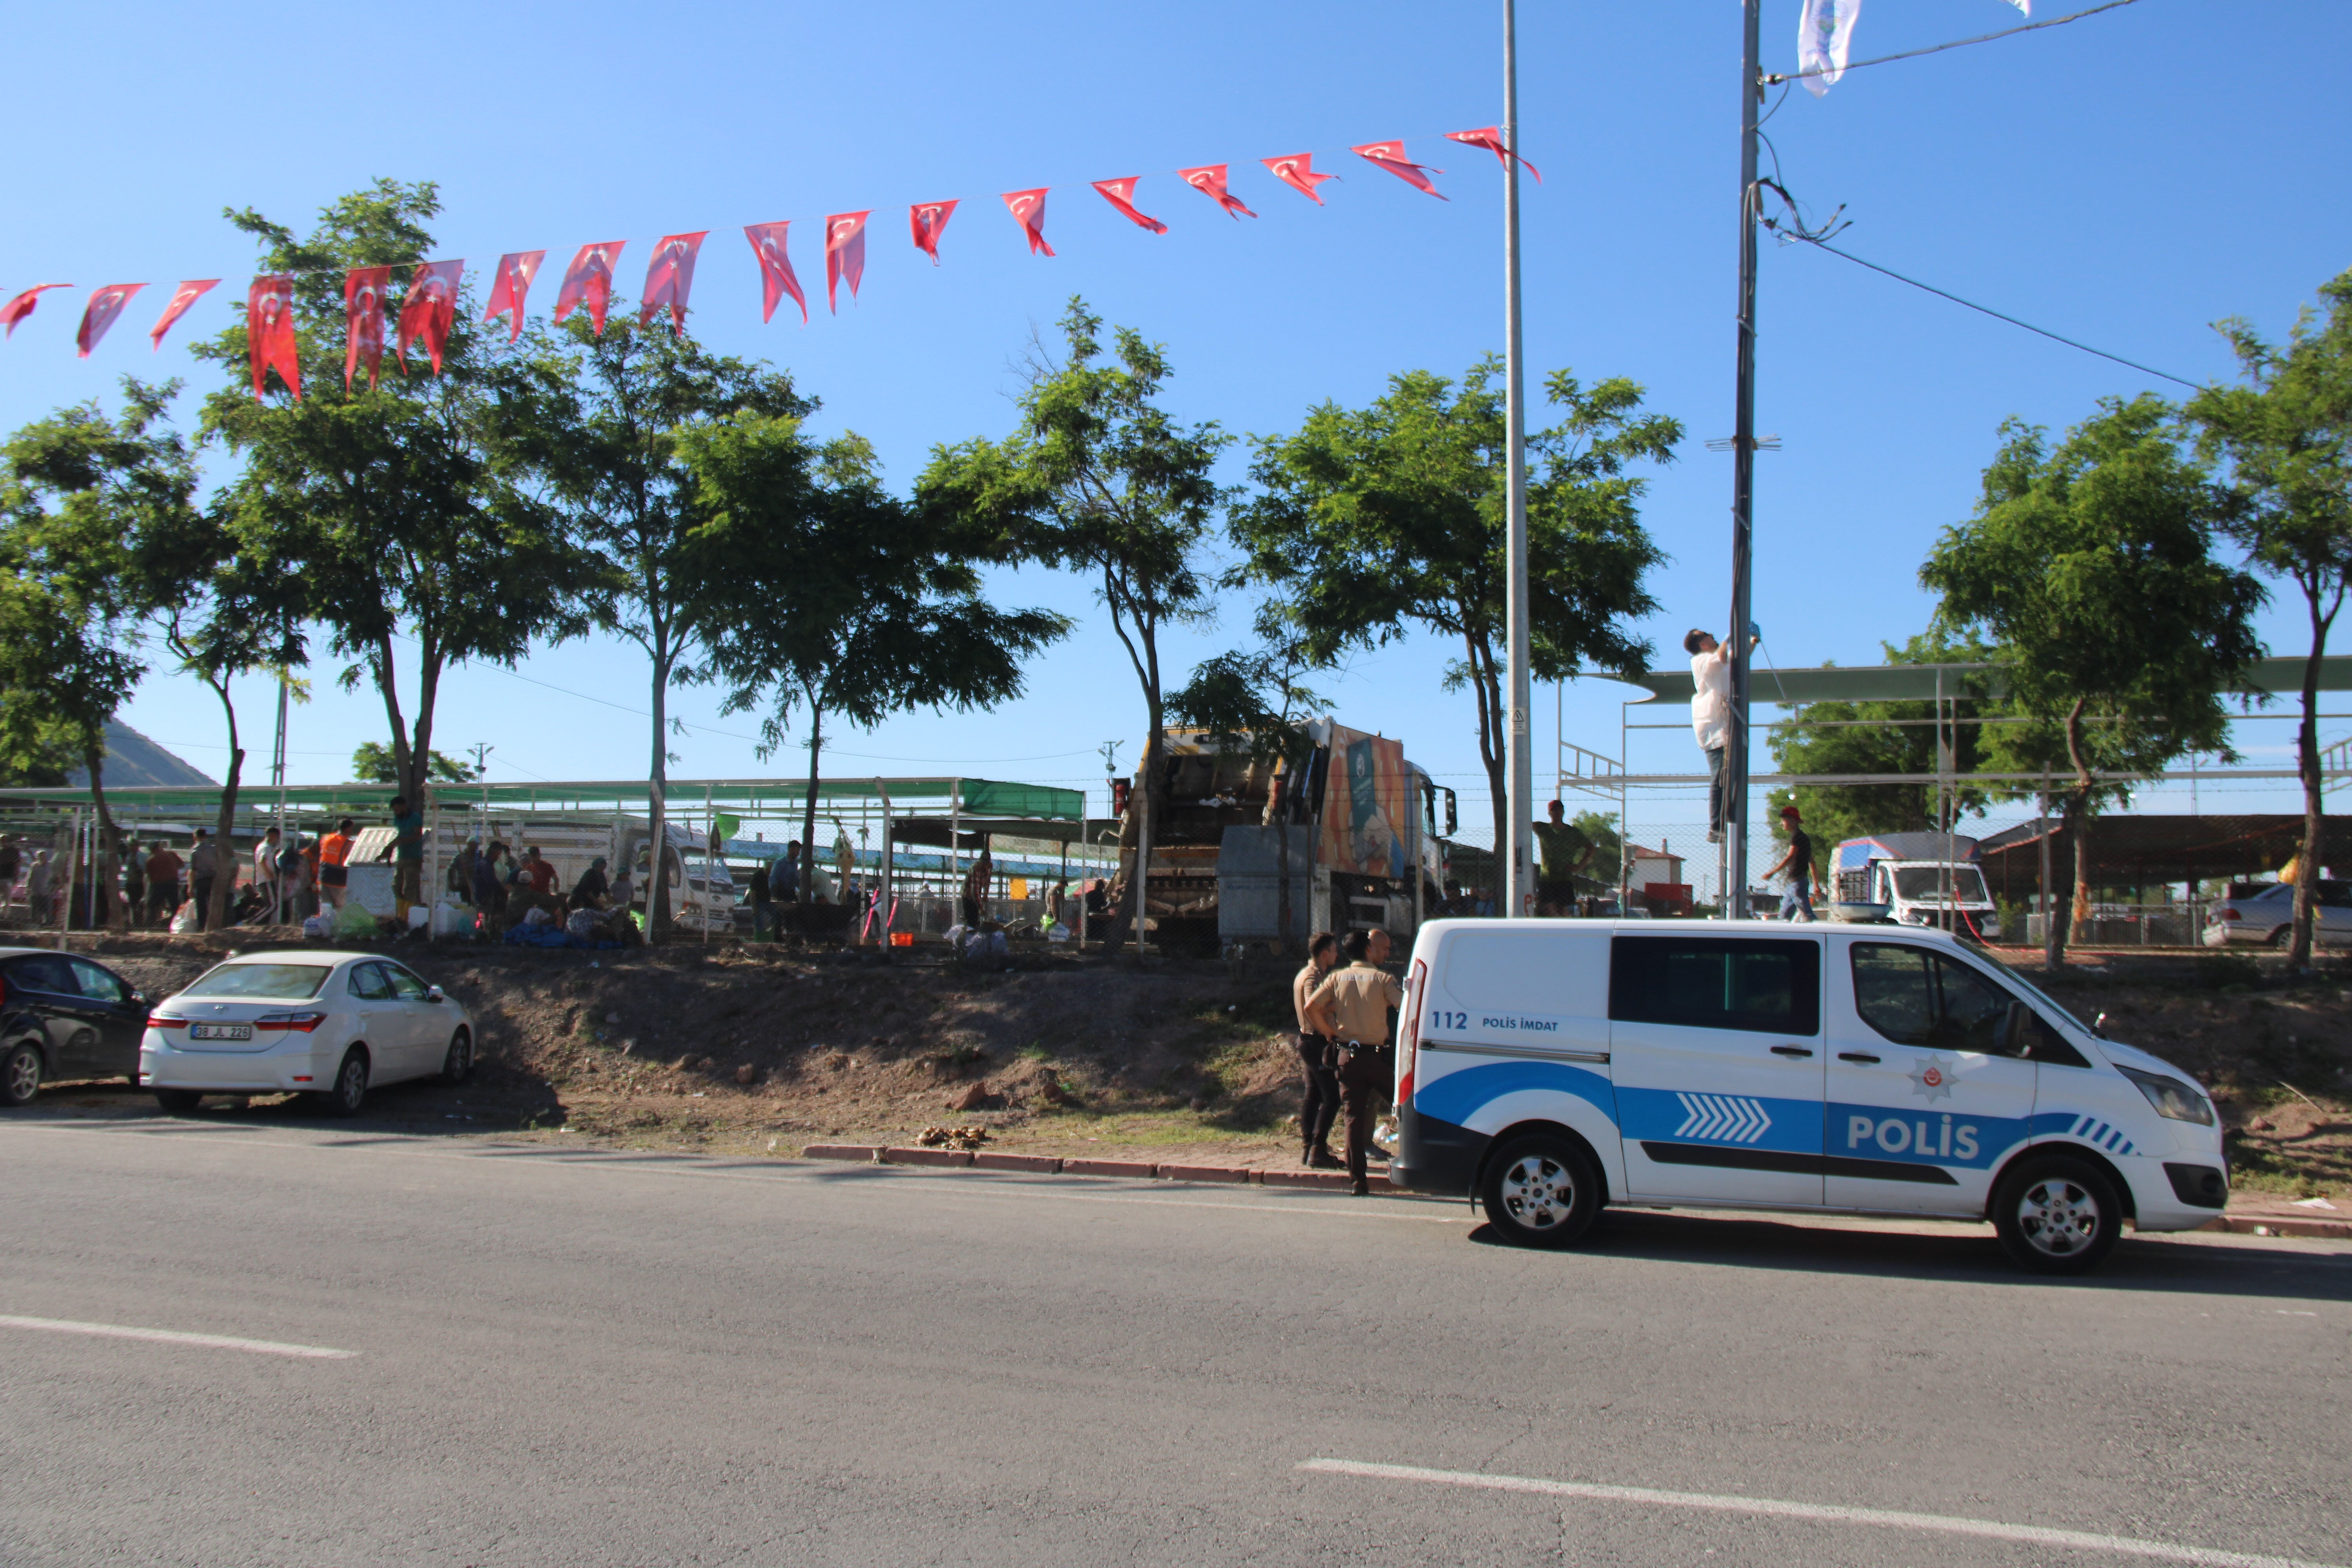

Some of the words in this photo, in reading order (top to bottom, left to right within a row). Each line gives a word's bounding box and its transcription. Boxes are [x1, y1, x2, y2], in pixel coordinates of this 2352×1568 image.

[1432, 1011, 1467, 1030] 112
[1483, 1016, 1516, 1029] POLİS
[1520, 1018, 1558, 1031] İMDAT
[197, 1027, 208, 1036] 38
[214, 1027, 224, 1037] JL
[231, 1027, 248, 1037] 226
[1847, 1114, 1979, 1160] POLİS
